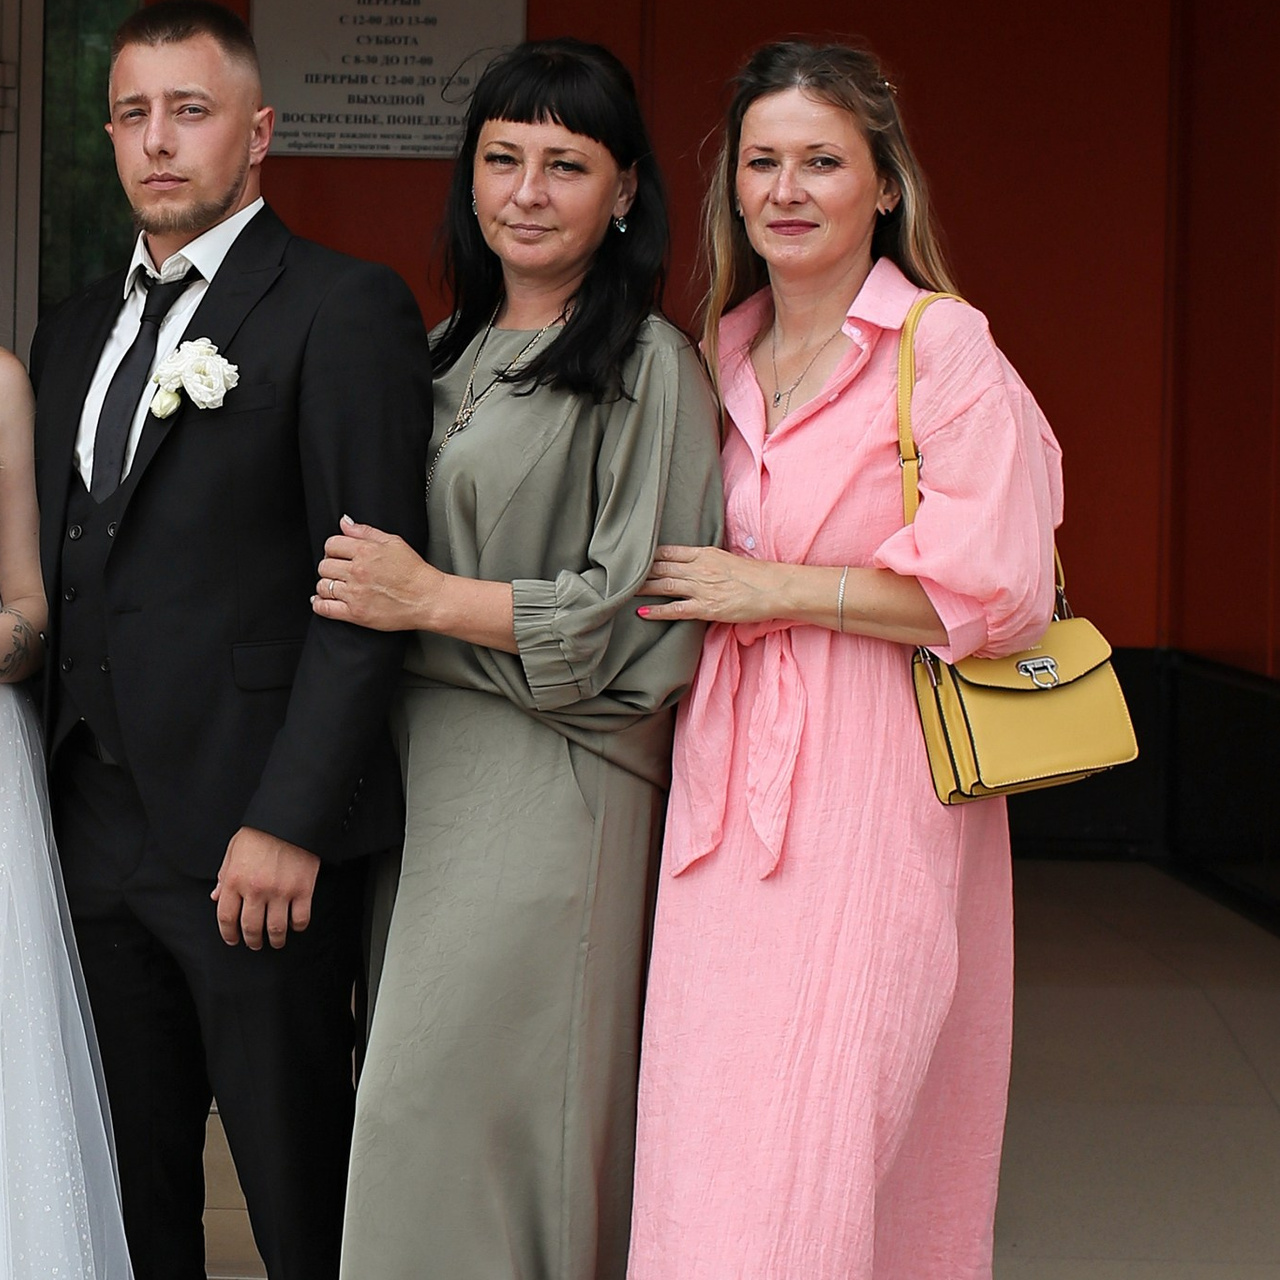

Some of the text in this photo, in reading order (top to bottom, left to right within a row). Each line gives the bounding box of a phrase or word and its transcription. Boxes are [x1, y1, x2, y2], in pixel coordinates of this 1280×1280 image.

[384, 16, 404, 27] ДО
[356, 35, 419, 46] СУББОТА
[380, 55, 400, 67] ДО
[304, 73, 368, 85] ПЕРЕРЫВ
[418, 75, 436, 87] ДО
[347, 92, 425, 106] ВЫХОДНОЙ
[282, 112, 468, 127] ВОСКРЕСЕНЬЕ, ПОНЕДЕЛЬ
